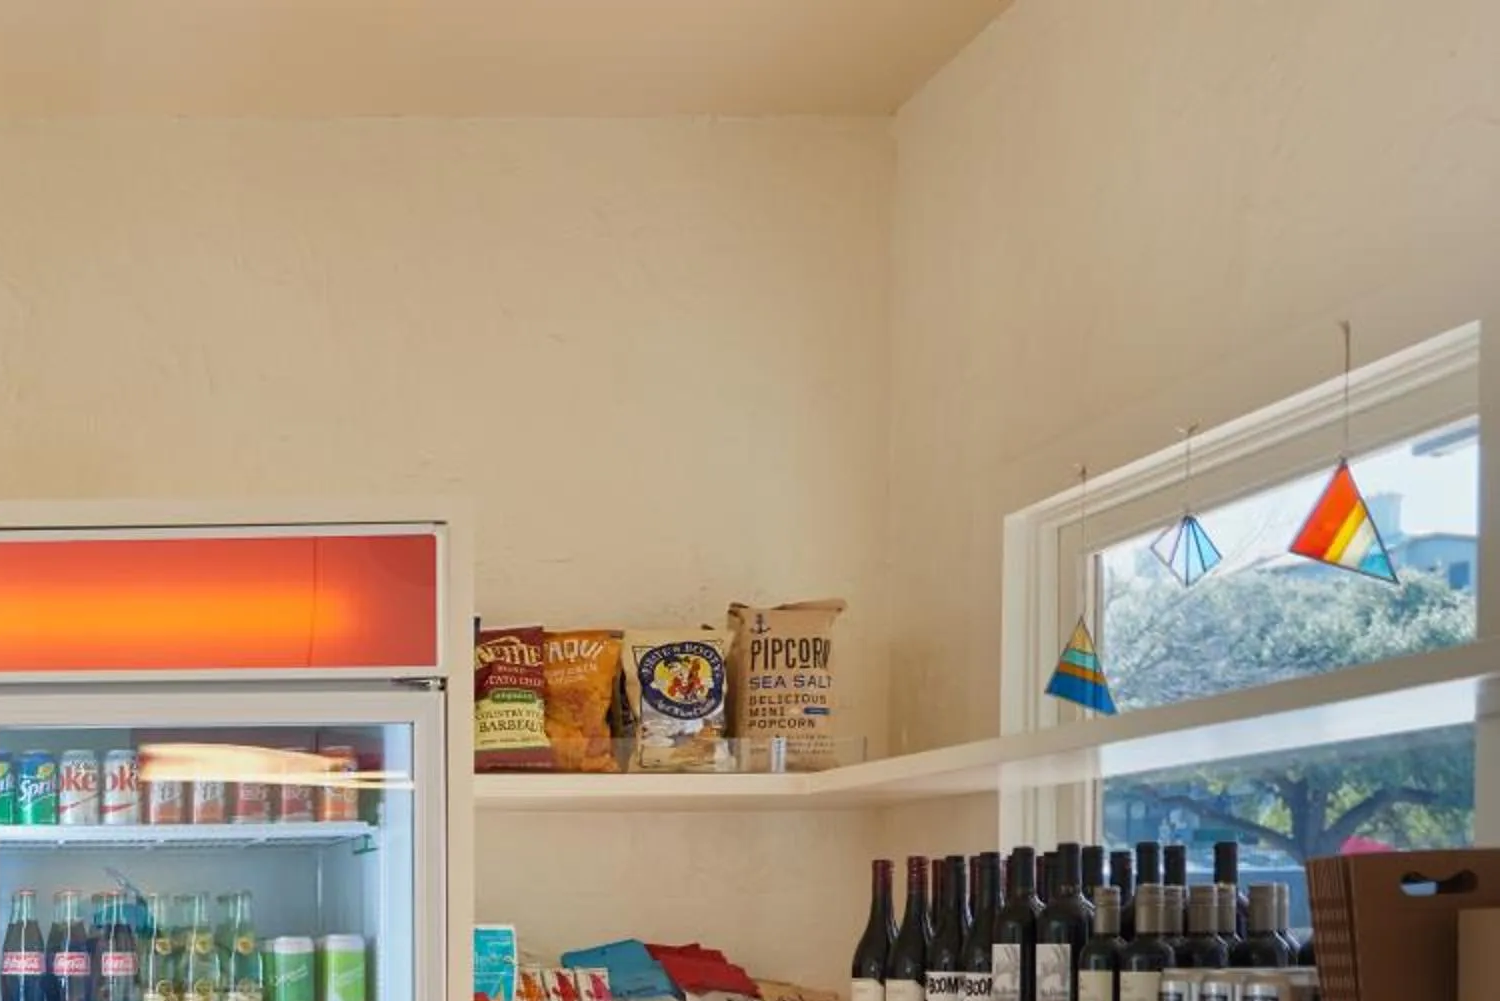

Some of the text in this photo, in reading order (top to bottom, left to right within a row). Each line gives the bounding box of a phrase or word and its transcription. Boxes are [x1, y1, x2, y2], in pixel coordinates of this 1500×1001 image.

[544, 638, 604, 663] AQUI
[751, 637, 831, 672] PIPCORN
[750, 675, 832, 690] SEA SALT
[749, 692, 827, 706] DELICIOUS
[749, 706, 785, 717] MINI
[479, 717, 544, 733] BARBEQU
[749, 718, 817, 730] POPCORN
